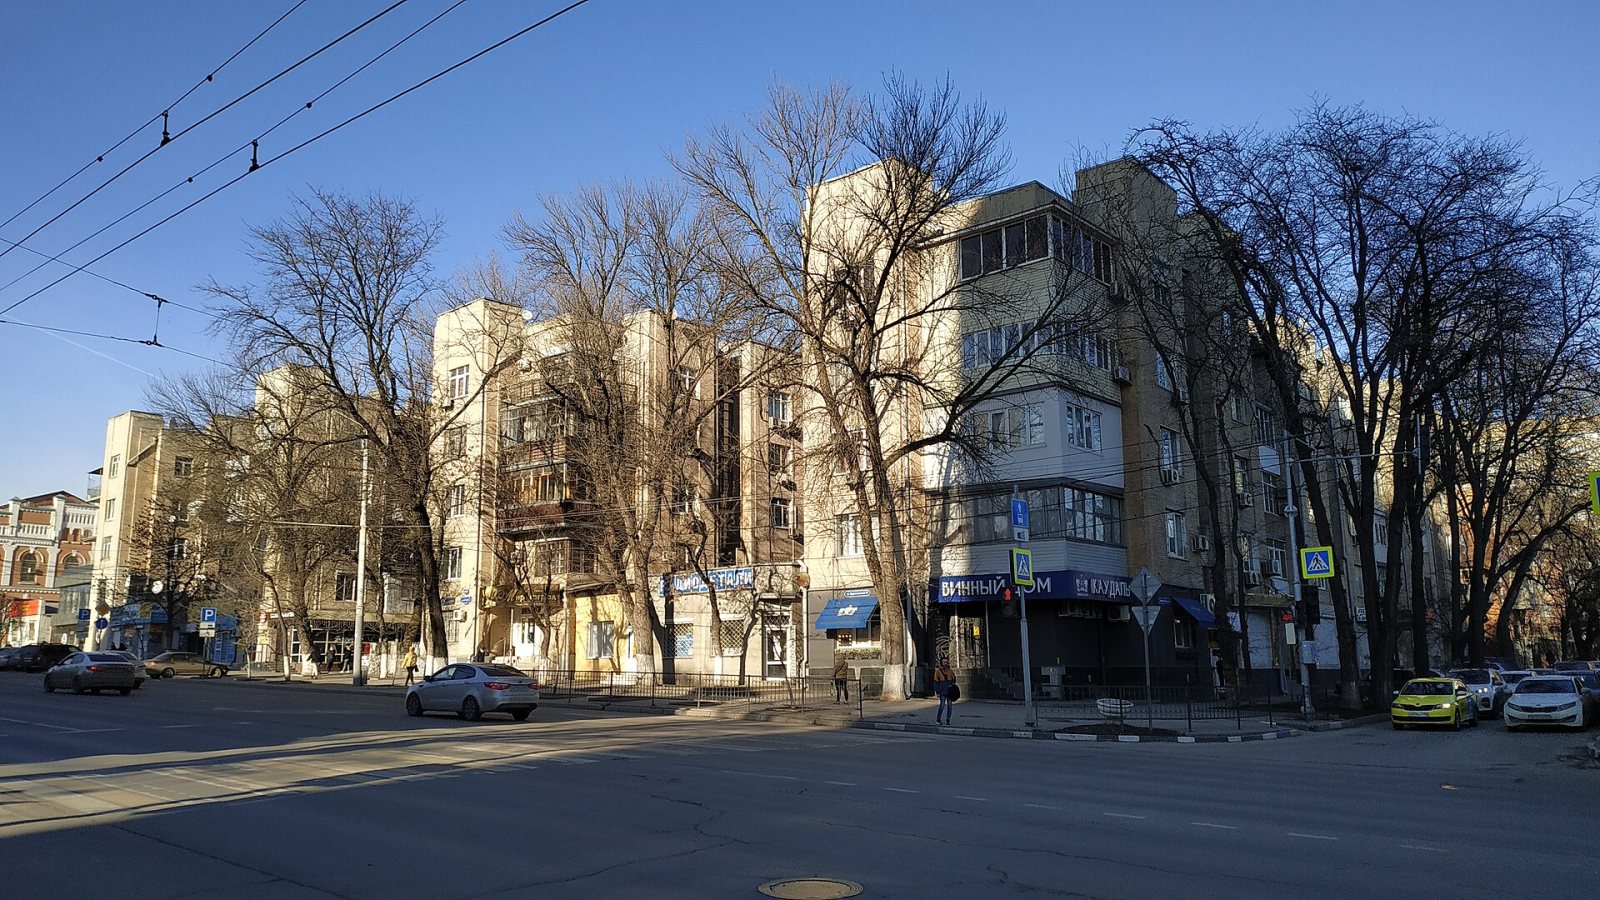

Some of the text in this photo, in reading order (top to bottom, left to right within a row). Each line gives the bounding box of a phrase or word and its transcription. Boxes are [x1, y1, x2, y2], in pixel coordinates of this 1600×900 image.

[941, 576, 1051, 597] ВИННЫЙ ОМ
[1091, 579, 1131, 598] КАУДАЛЬ
[205, 609, 214, 621] P
